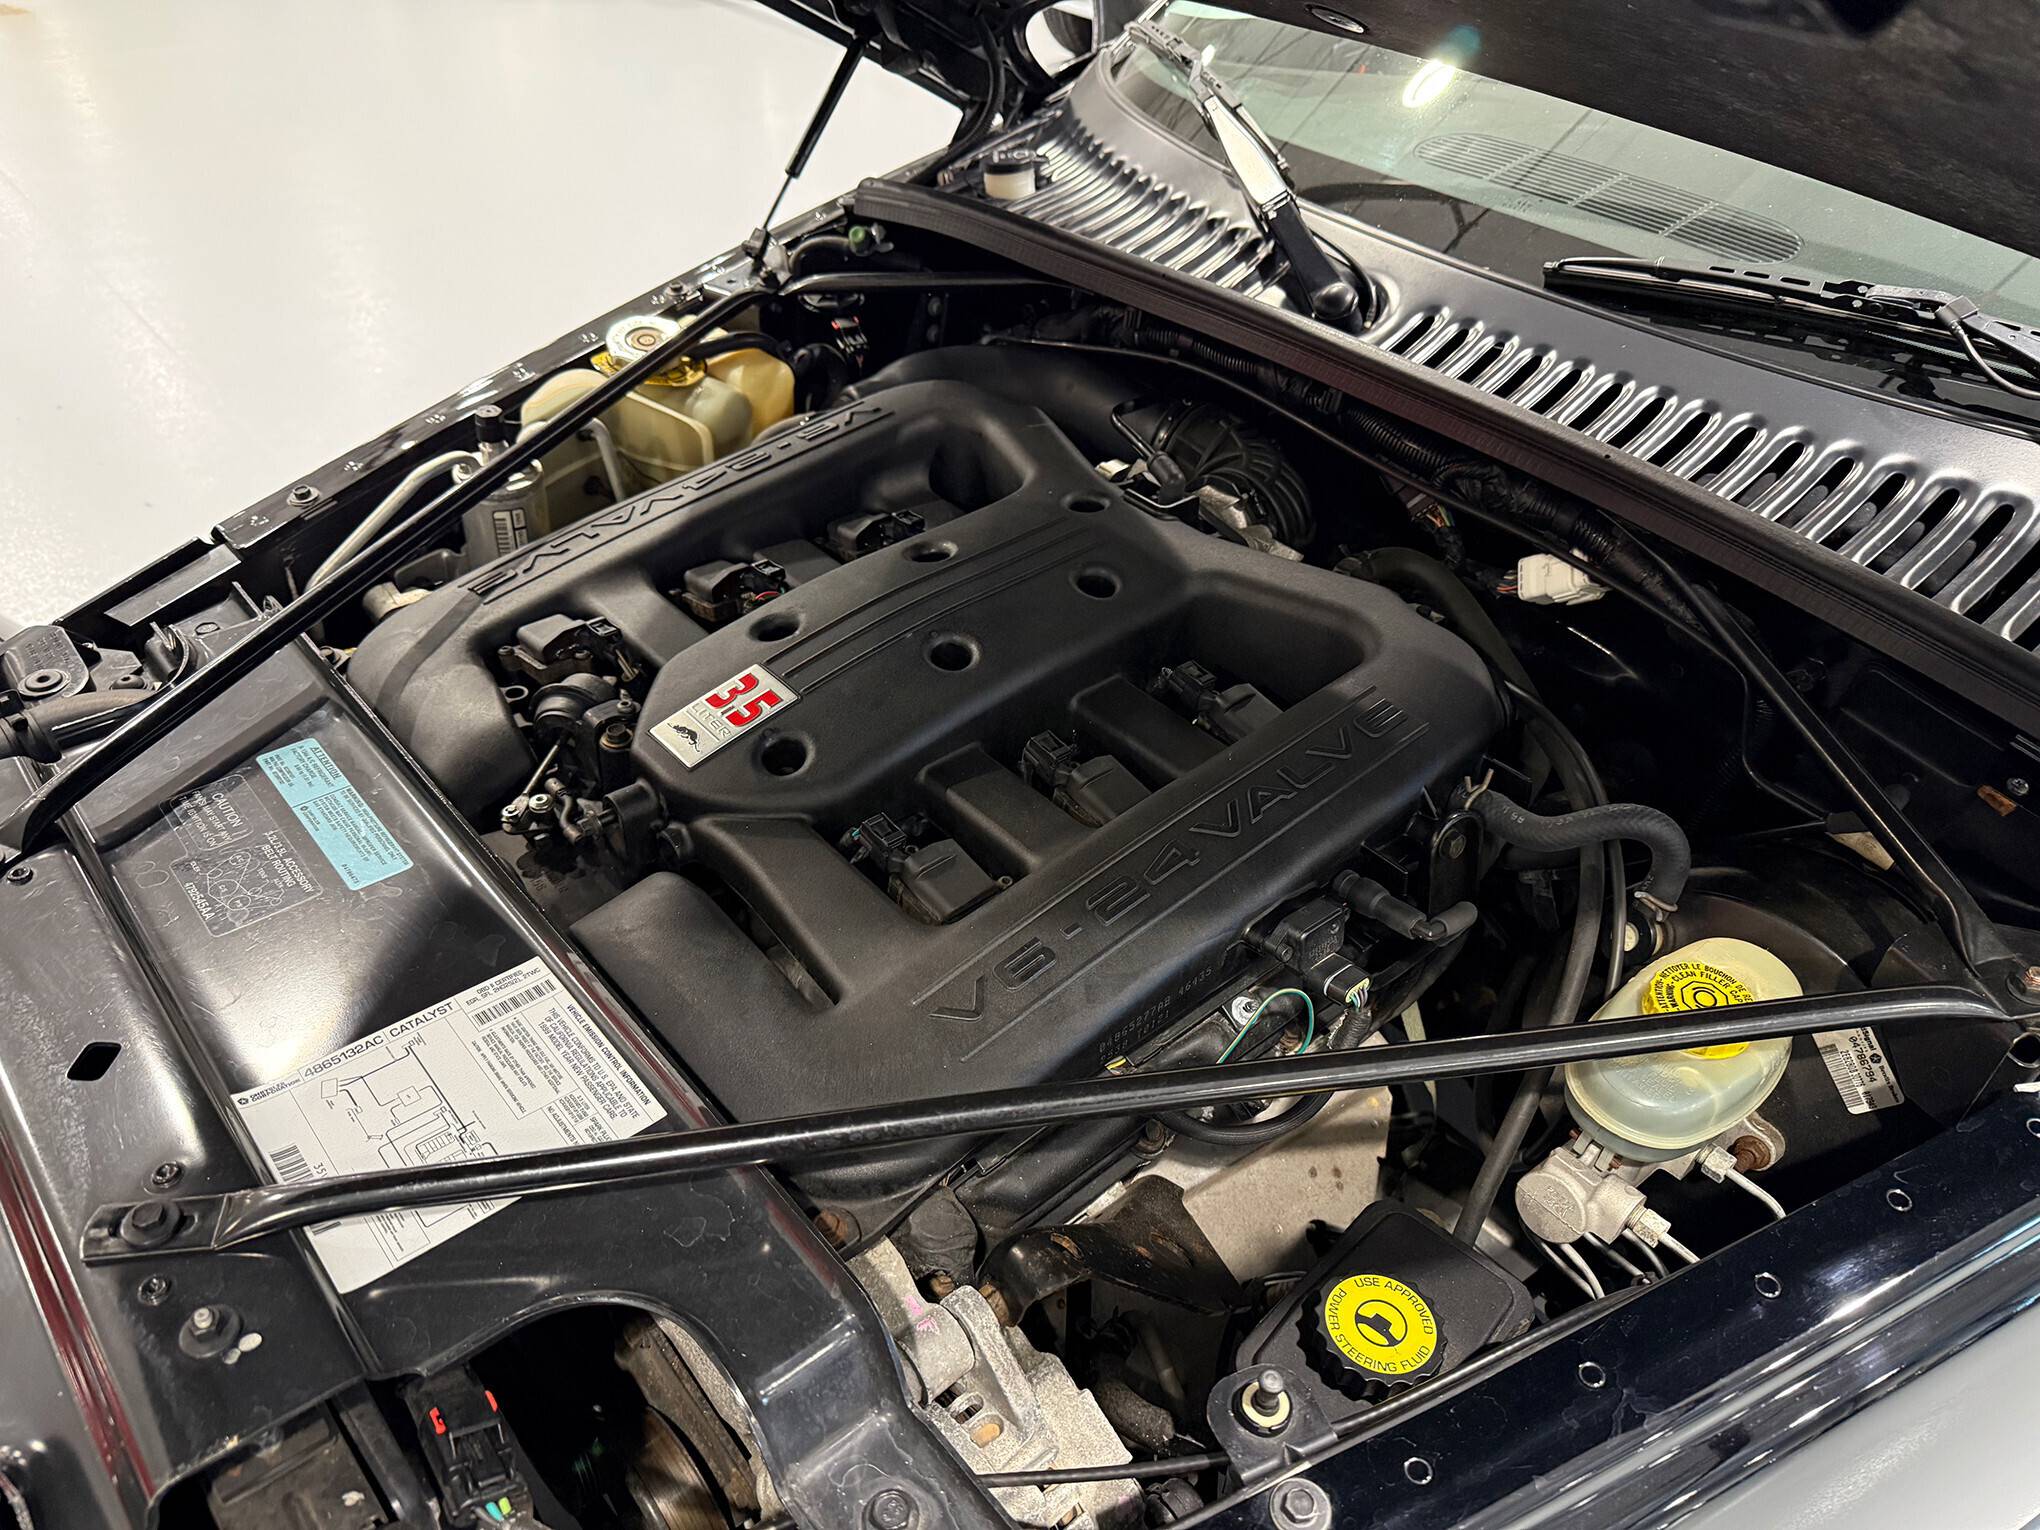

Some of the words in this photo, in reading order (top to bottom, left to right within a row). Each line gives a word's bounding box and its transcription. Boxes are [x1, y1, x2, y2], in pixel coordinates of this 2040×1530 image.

[467, 495, 684, 596] VALVE
[691, 702, 731, 739] LITER
[310, 746, 342, 778] ATTENTION
[1189, 698, 1408, 839] VALVE
[210, 791, 244, 828] CAUTION
[260, 844, 278, 861] BELT
[270, 859, 296, 887] ROUTING
[282, 856, 314, 894] ACCESSORY
[182, 879, 216, 920] 4792545AA
[1671, 970, 1697, 982] CLEAN
[1700, 971, 1731, 989] FILLER
[1729, 988, 1743, 1003] CAP
[1692, 963, 1701, 971] LE
[1704, 965, 1737, 985] BOUCHON
[1735, 984, 1747, 993] DE
[301, 1034, 385, 1078] 4865132AC
[387, 1001, 456, 1038] CATALYST
[565, 1003, 586, 1024] VEHICLE
[581, 1022, 605, 1048] EMISSION
[599, 1046, 624, 1071] CONTROL
[618, 1068, 652, 1106] INFORMATION
[1847, 1035, 1877, 1083] 04786794
[546, 1032, 565, 1051] MODEL
[559, 1049, 575, 1065] YEAR
[569, 1062, 585, 1077] NEW
[579, 1074, 607, 1106] PASSENGER
[548, 1022, 575, 1050] CALIFORNIA
[568, 1048, 600, 1082] REGULATIONS
[593, 1079, 622, 1111] APPLICABLE
[555, 1017, 576, 1038] VEHICLE
[570, 1035, 596, 1064] CONFORMS
[612, 1089, 628, 1103] AND
[621, 1100, 640, 1119] STATE
[550, 1112, 577, 1142] ADJUSTMENTS
[1328, 1288, 1347, 1331] POWER
[1354, 1277, 1380, 1288] USE
[1384, 1281, 1434, 1335] APPROVED
[1335, 1333, 1398, 1372] STEERING
[1400, 1345, 1430, 1371] FLUID
